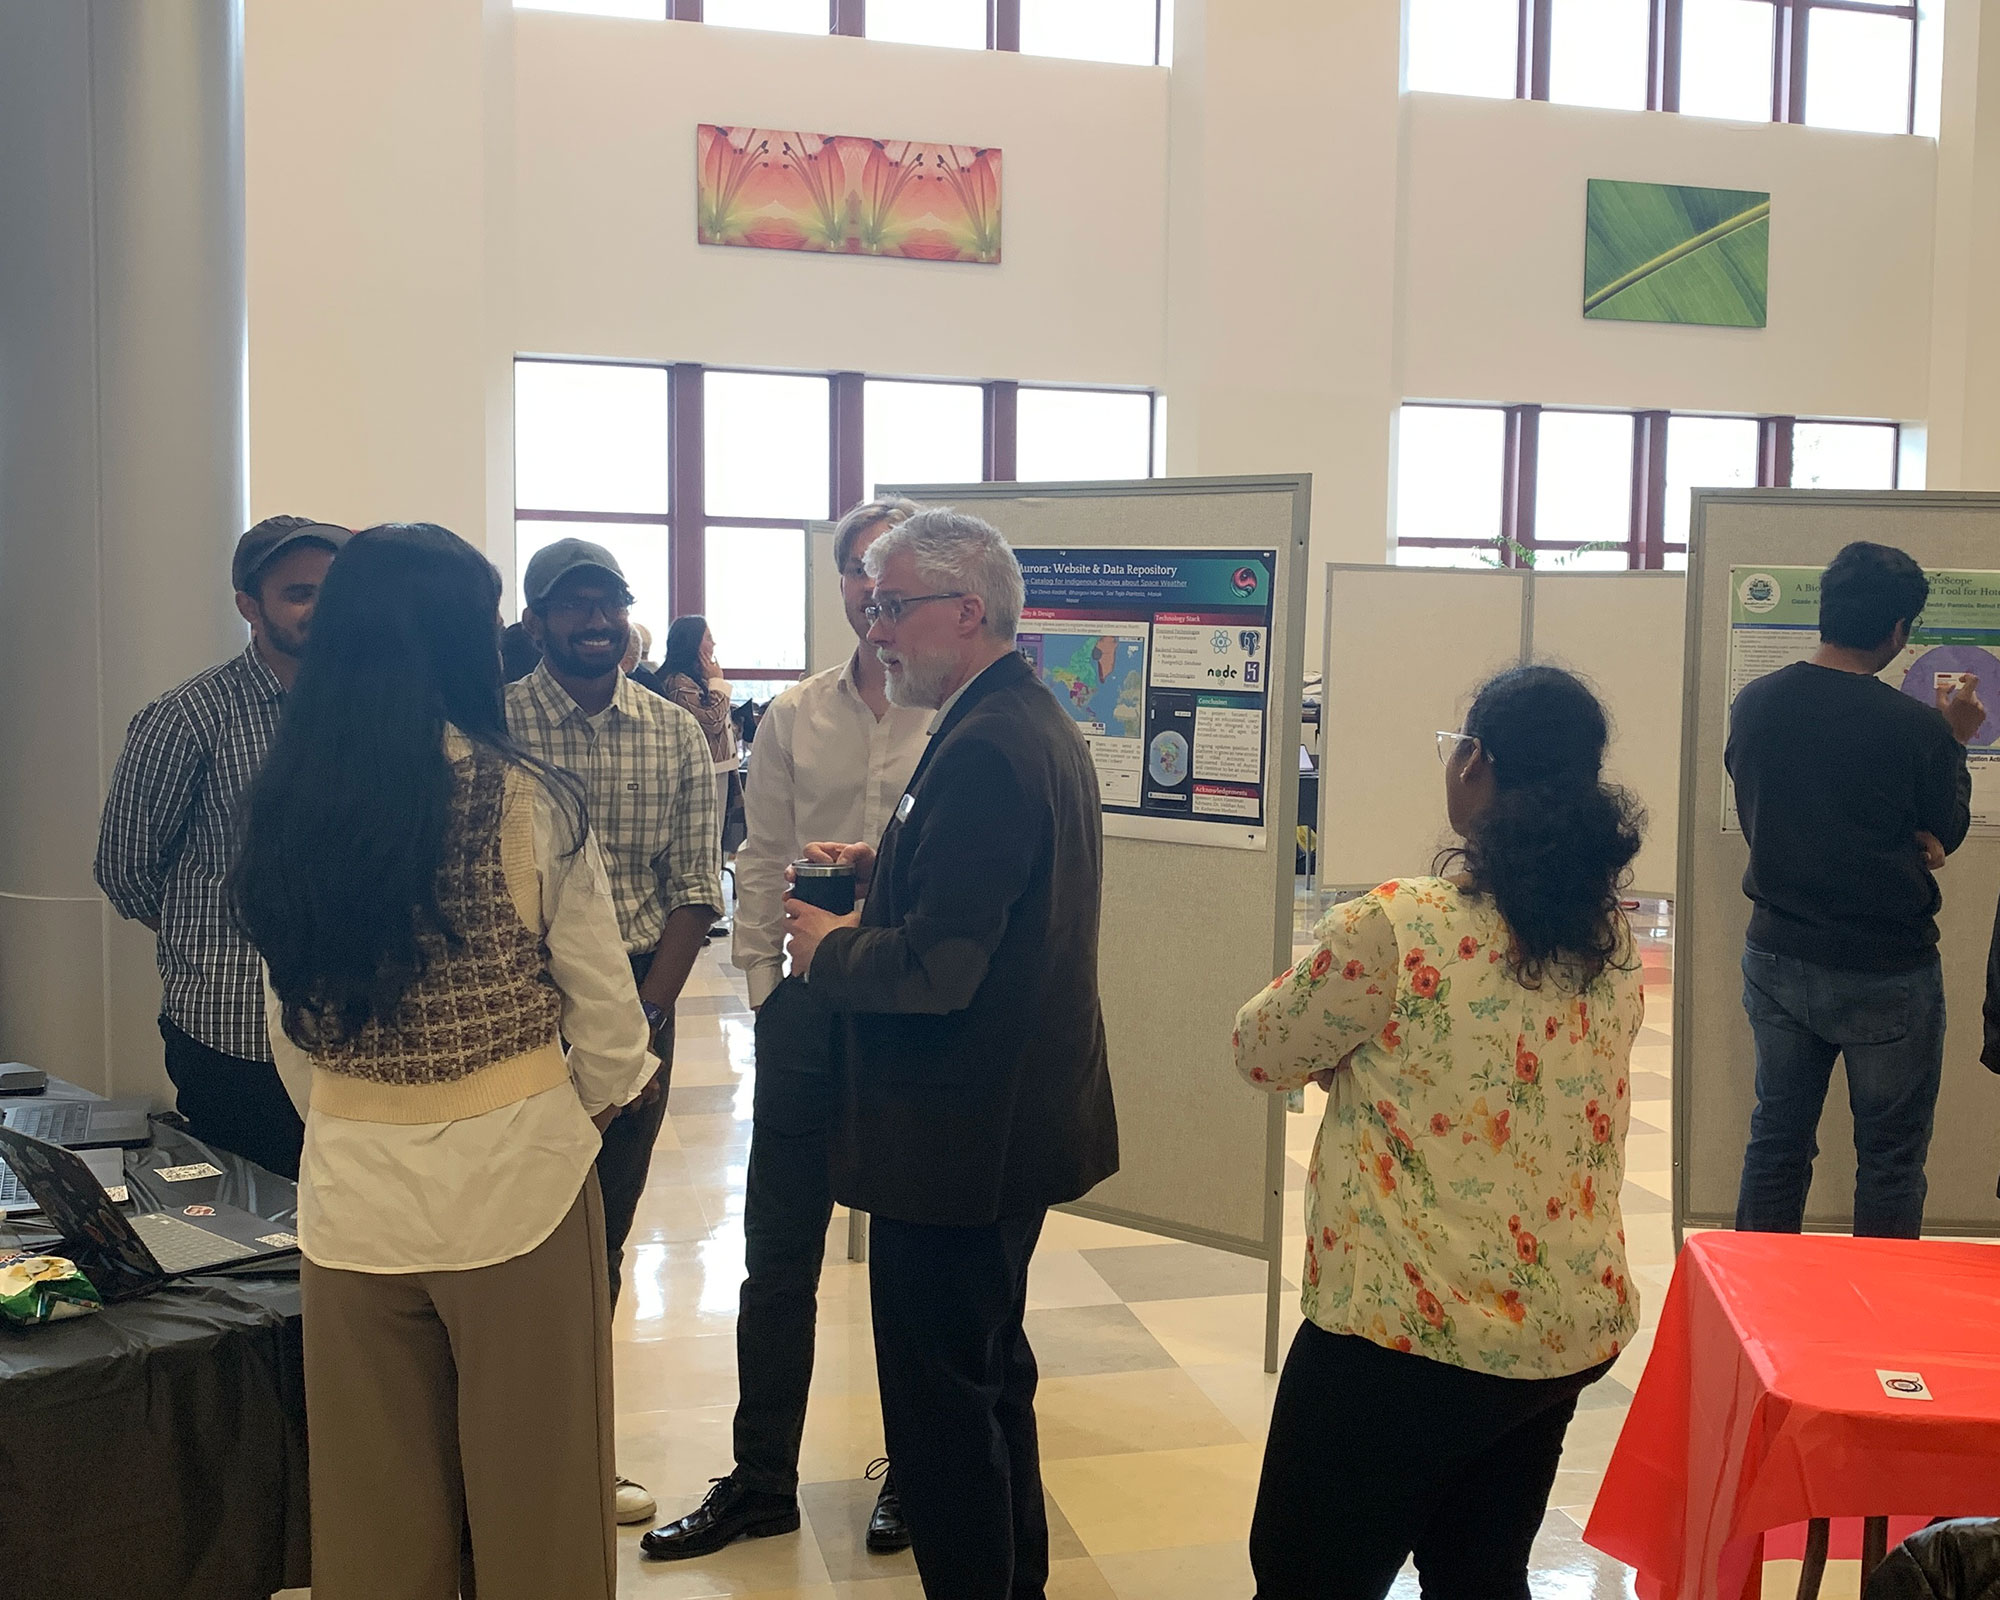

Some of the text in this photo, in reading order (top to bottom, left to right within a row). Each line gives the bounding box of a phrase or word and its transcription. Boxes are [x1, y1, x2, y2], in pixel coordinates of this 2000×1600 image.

[1053, 563, 1090, 574] Website
[1092, 564, 1100, 574] &
[1103, 564, 1125, 574] Data
[1127, 564, 1177, 578] Repository
[1929, 576, 1972, 587] ProScope
[1796, 583, 1820, 592] A Bio
[1940, 587, 1961, 595] Tool
[1964, 587, 1977, 596] for
[1155, 615, 1185, 623] Technology
[1207, 665, 1237, 678] node
